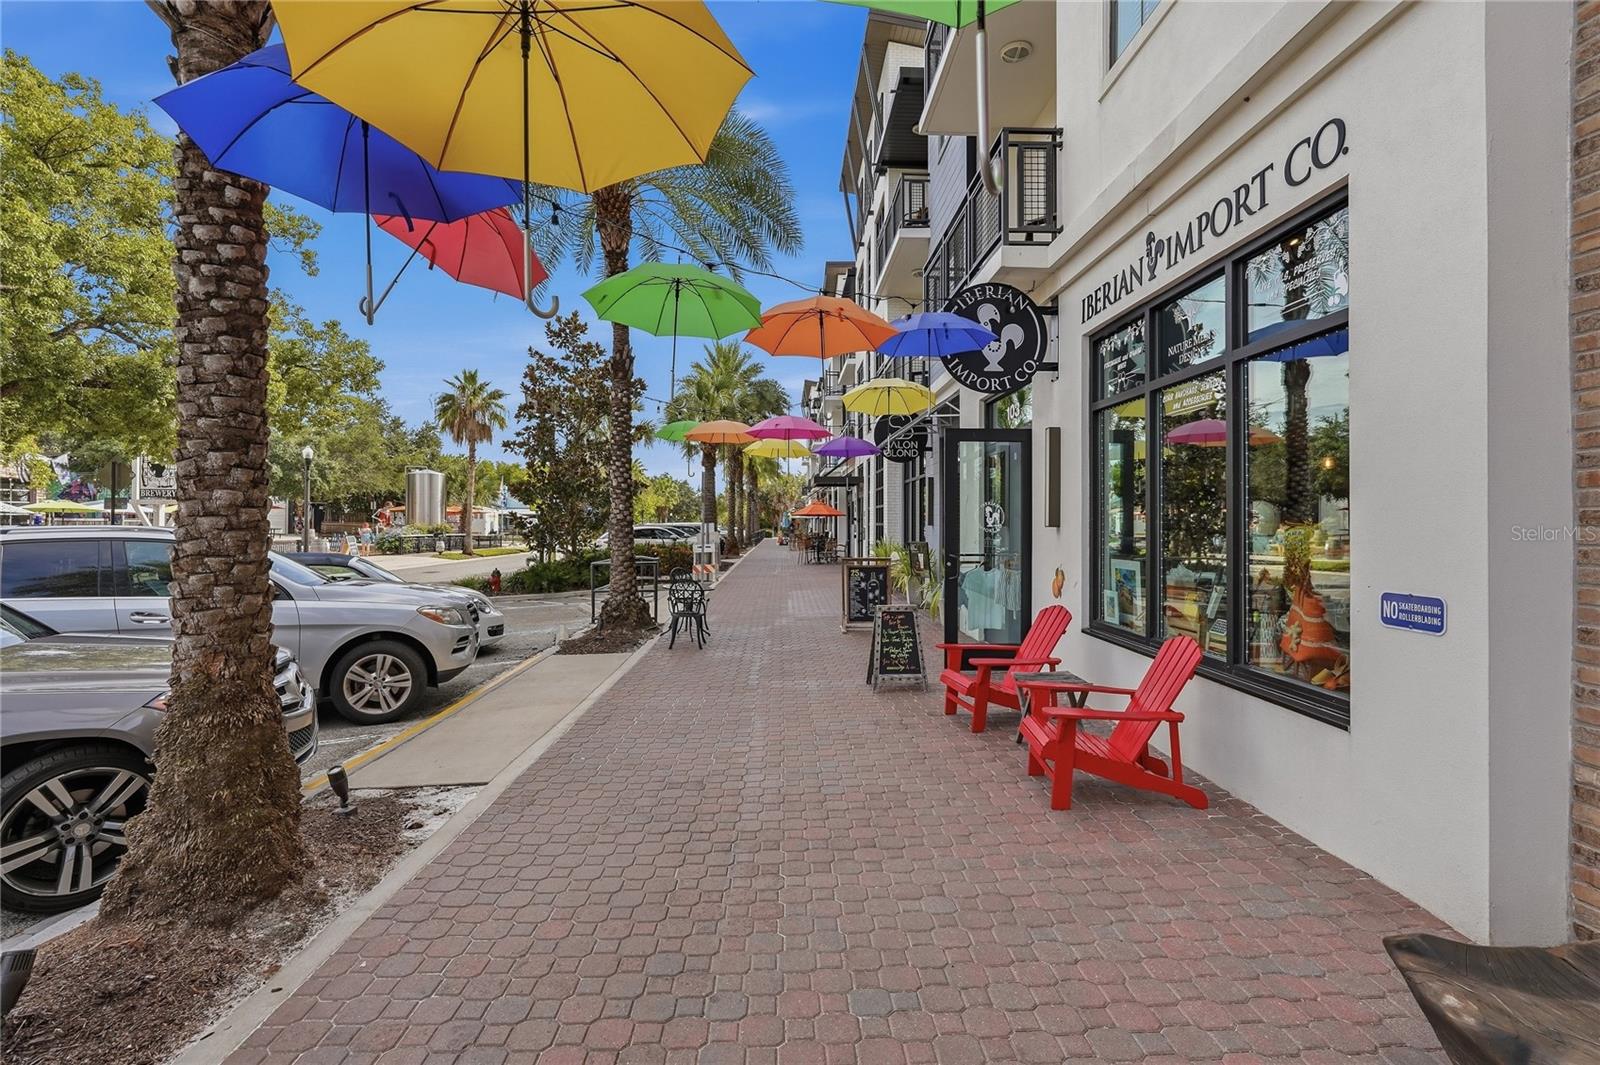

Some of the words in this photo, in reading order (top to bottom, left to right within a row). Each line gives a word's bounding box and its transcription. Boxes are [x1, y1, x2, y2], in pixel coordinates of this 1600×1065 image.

[1081, 257, 1143, 324] IBERIAN
[1165, 163, 1273, 270] IMPORT
[1284, 118, 1349, 187] CO.
[957, 285, 1029, 311] IBERIAN
[1168, 338, 1193, 357] NATURE
[948, 358, 1012, 391] IMPORT
[1007, 402, 1021, 421] 103
[1383, 600, 1398, 619] NO
[1399, 602, 1442, 615] SKATEBOARDING
[1399, 612, 1442, 626] ROLLERBLADING
